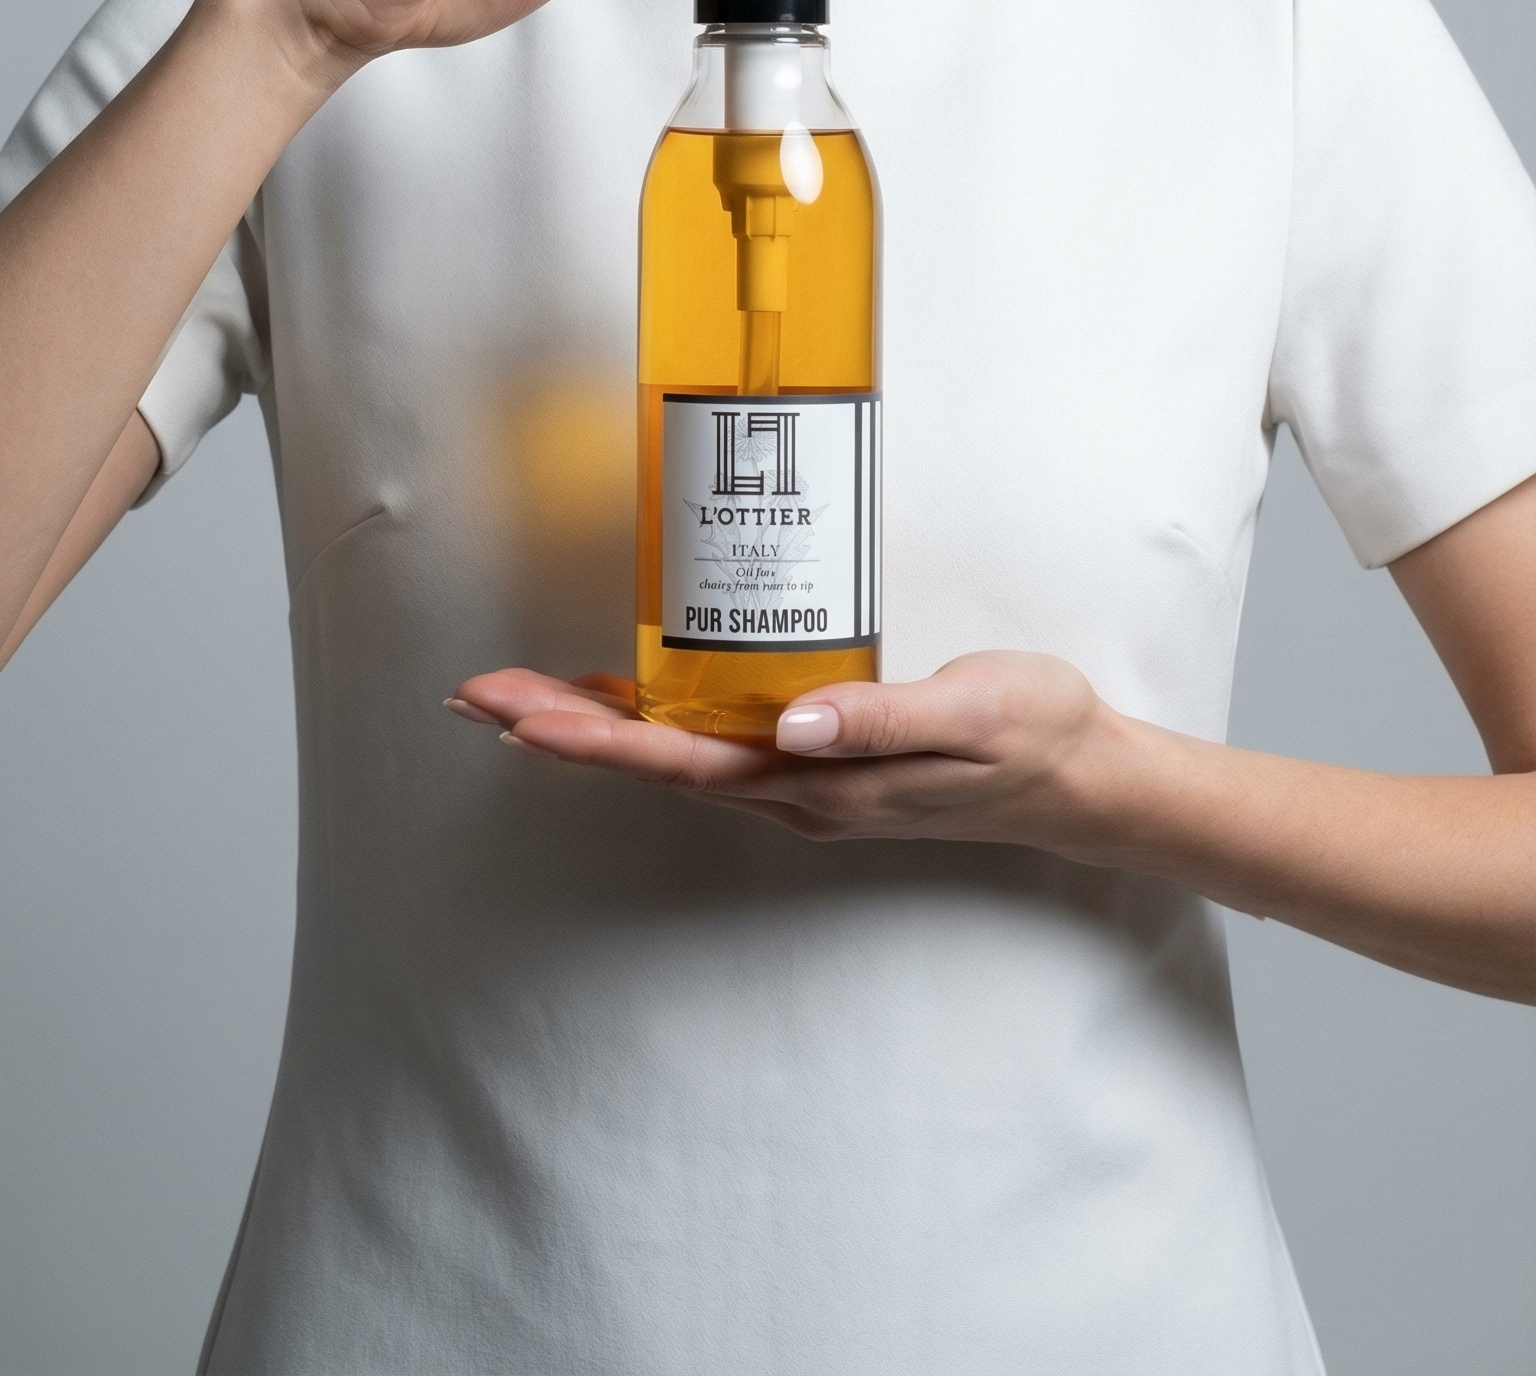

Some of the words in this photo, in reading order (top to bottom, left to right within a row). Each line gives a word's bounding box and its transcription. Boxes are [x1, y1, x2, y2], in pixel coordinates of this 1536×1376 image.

[700, 506, 811, 526] L'OTTIER
[731, 544, 780, 557] ITALY
[787, 581, 797, 590] to
[686, 606, 722, 632] PUR
[729, 608, 828, 633] SHAMPOO
